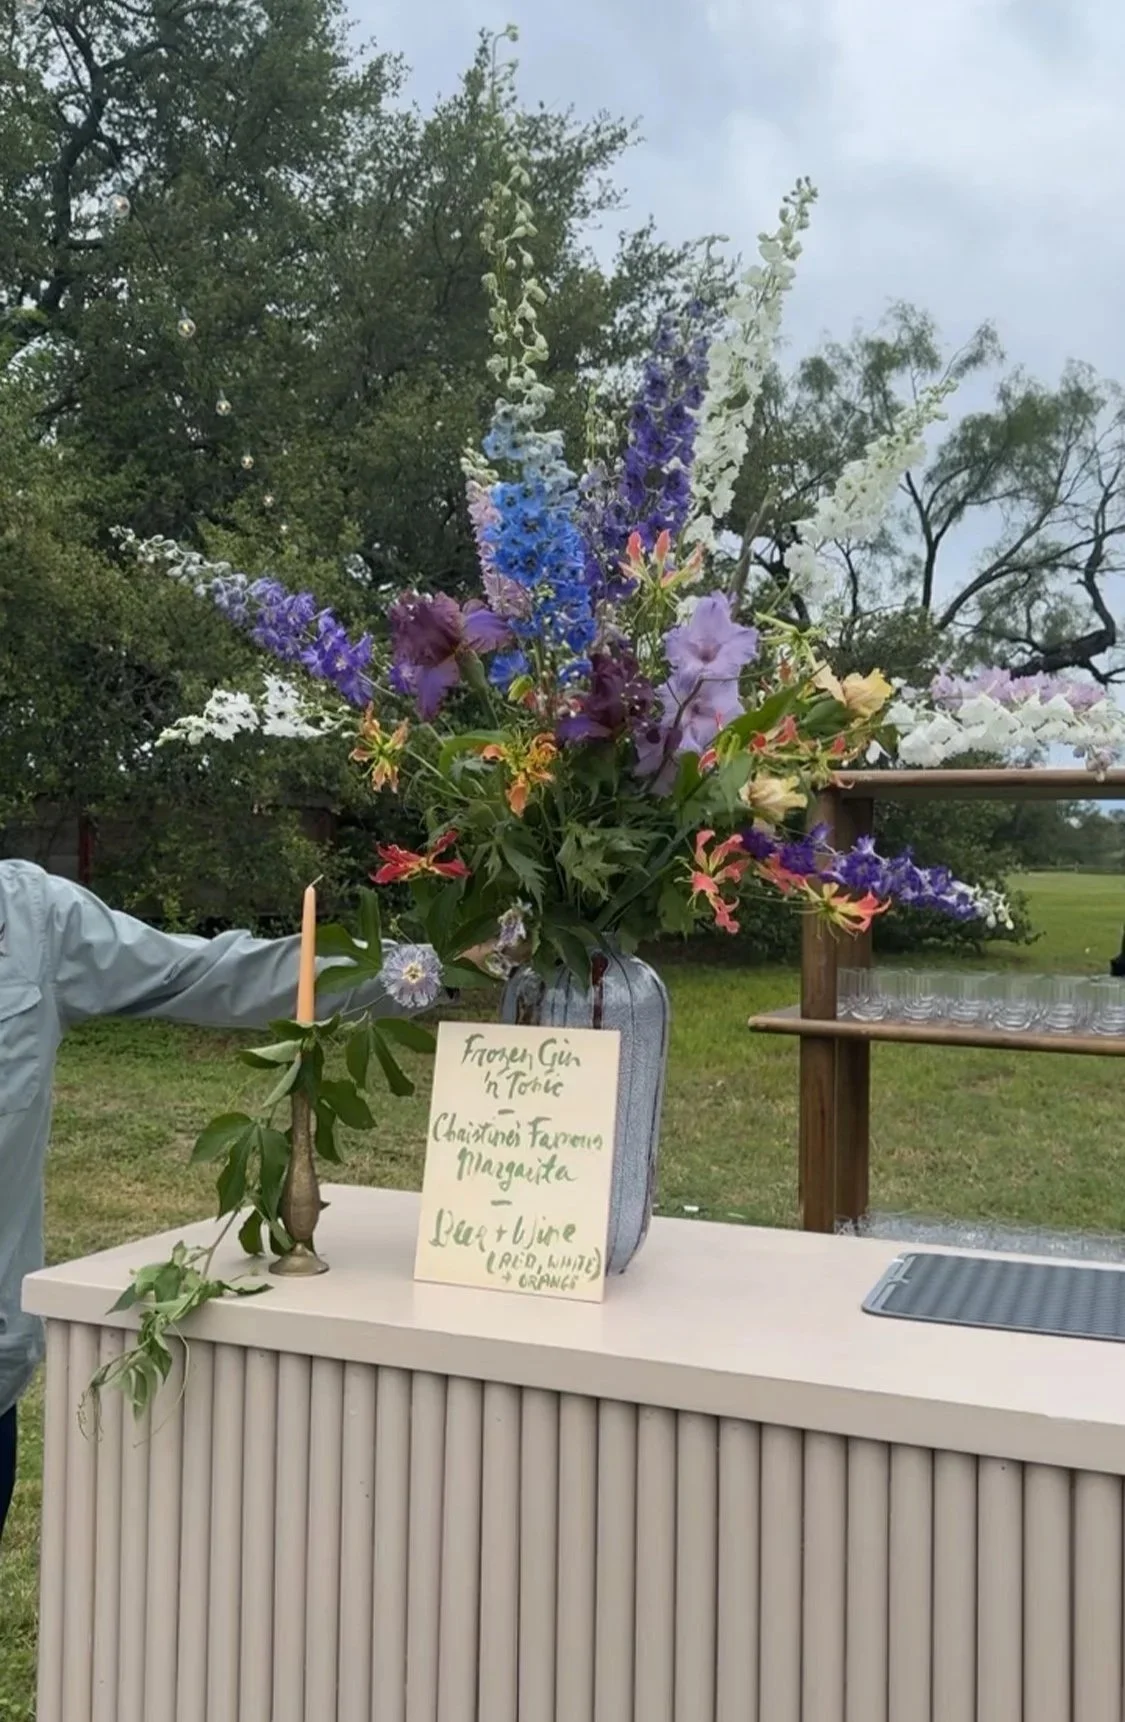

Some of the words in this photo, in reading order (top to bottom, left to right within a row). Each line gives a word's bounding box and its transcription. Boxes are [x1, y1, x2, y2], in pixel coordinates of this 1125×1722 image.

[461, 1033, 533, 1076] Frozen
[538, 1037, 581, 1075] Gin
[506, 1071, 564, 1099] Tonic
[528, 1117, 604, 1151] Famous
[456, 1147, 578, 1192] Margarita
[496, 1224, 508, 1243] +
[512, 1213, 577, 1250] Wine
[518, 1273, 579, 1291] ORANGE
